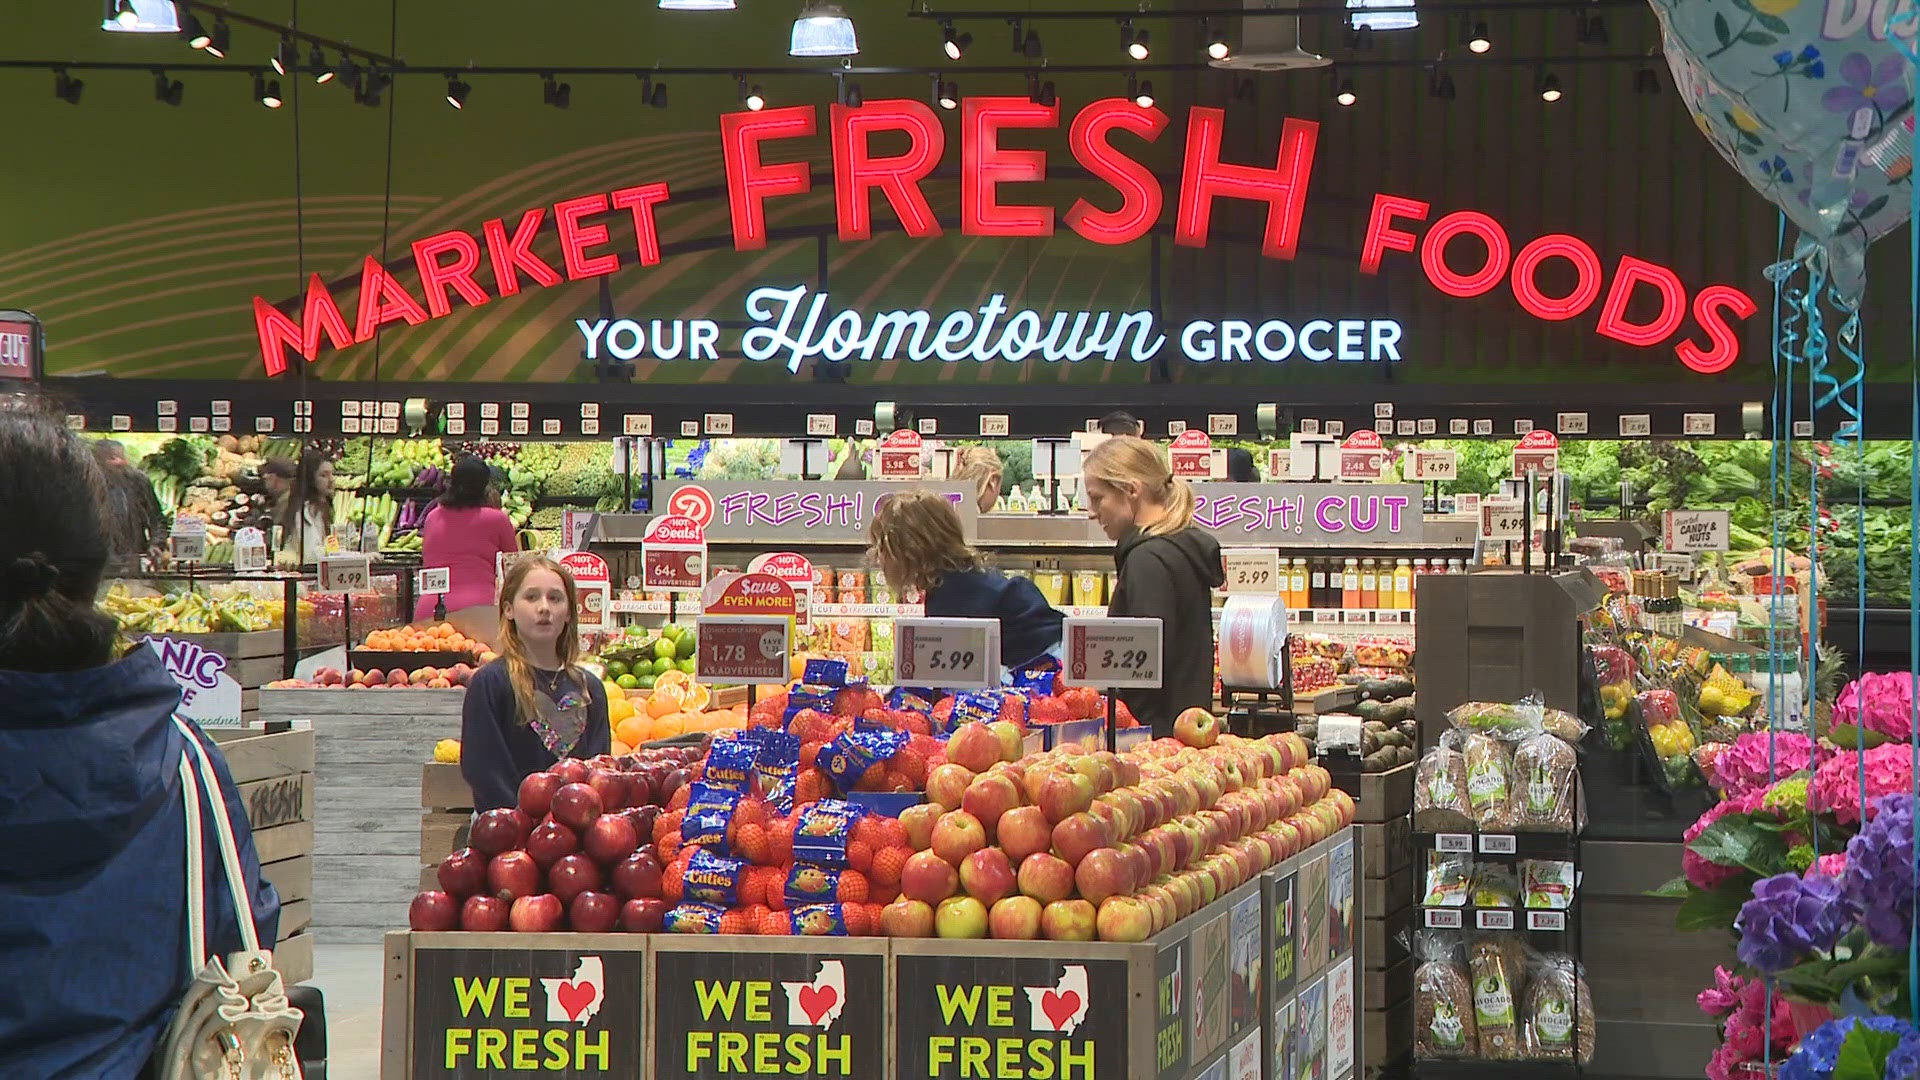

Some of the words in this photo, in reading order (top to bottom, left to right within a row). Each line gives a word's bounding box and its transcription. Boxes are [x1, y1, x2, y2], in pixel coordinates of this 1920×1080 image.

[253, 182, 670, 377] MARKET
[719, 96, 1320, 261] FRESH
[1359, 193, 1759, 375] FOODS
[576, 319, 720, 361] YOUR
[741, 284, 1166, 375] Hometown
[1181, 319, 1402, 362] GROCER
[891, 436, 919, 446] Deals!
[1349, 437, 1379, 447] Deals!
[1525, 437, 1555, 446] Deals!
[886, 461, 904, 469] 5.98
[1176, 461, 1195, 470] 3.48
[1345, 462, 1365, 471] 2.48
[1429, 463, 1450, 472] 4.99
[720, 491, 862, 530] FRESH!
[1194, 494, 1305, 534] RESH!
[1314, 495, 1408, 533] CUT
[672, 519, 688, 527] HOT
[1680, 521, 1710, 535] CANDY
[1710, 521, 1717, 531] &
[658, 526, 700, 540] Deals!
[1689, 531, 1711, 543] NUTS
[573, 555, 591, 563] HOT
[778, 556, 798, 564] HOT
[560, 562, 604, 577] Deals!
[763, 562, 809, 577] Deals!
[1238, 570, 1269, 584] 3.99
[337, 573, 362, 584] 4.99
[648, 602, 663, 611] CUT
[724, 596, 753, 606] EVEN
[755, 597, 793, 607] MORE!
[711, 644, 746, 662] 1.78
[930, 650, 974, 670] 5.99
[1101, 649, 1147, 669] 3.29
[703, 666, 716, 674] AS
[718, 666, 779, 676] ADVERTISED!
[1132, 670, 1143, 679] Per
[1144, 671, 1153, 679] LB
[706, 765, 746, 783] Cuties
[752, 761, 791, 777] Cuties
[688, 871, 732, 888] Cuties
[1275, 939, 1293, 982] FRESH
[453, 976, 531, 1019] WE
[694, 980, 772, 1022] WE
[1158, 974, 1172, 1020] WE
[935, 984, 1014, 1027] WE
[445, 1027, 609, 1071] FRESH
[687, 1031, 852, 1075] FRESH
[1157, 1017, 1183, 1075] FRESH
[928, 1036, 1095, 1080] FRESH
